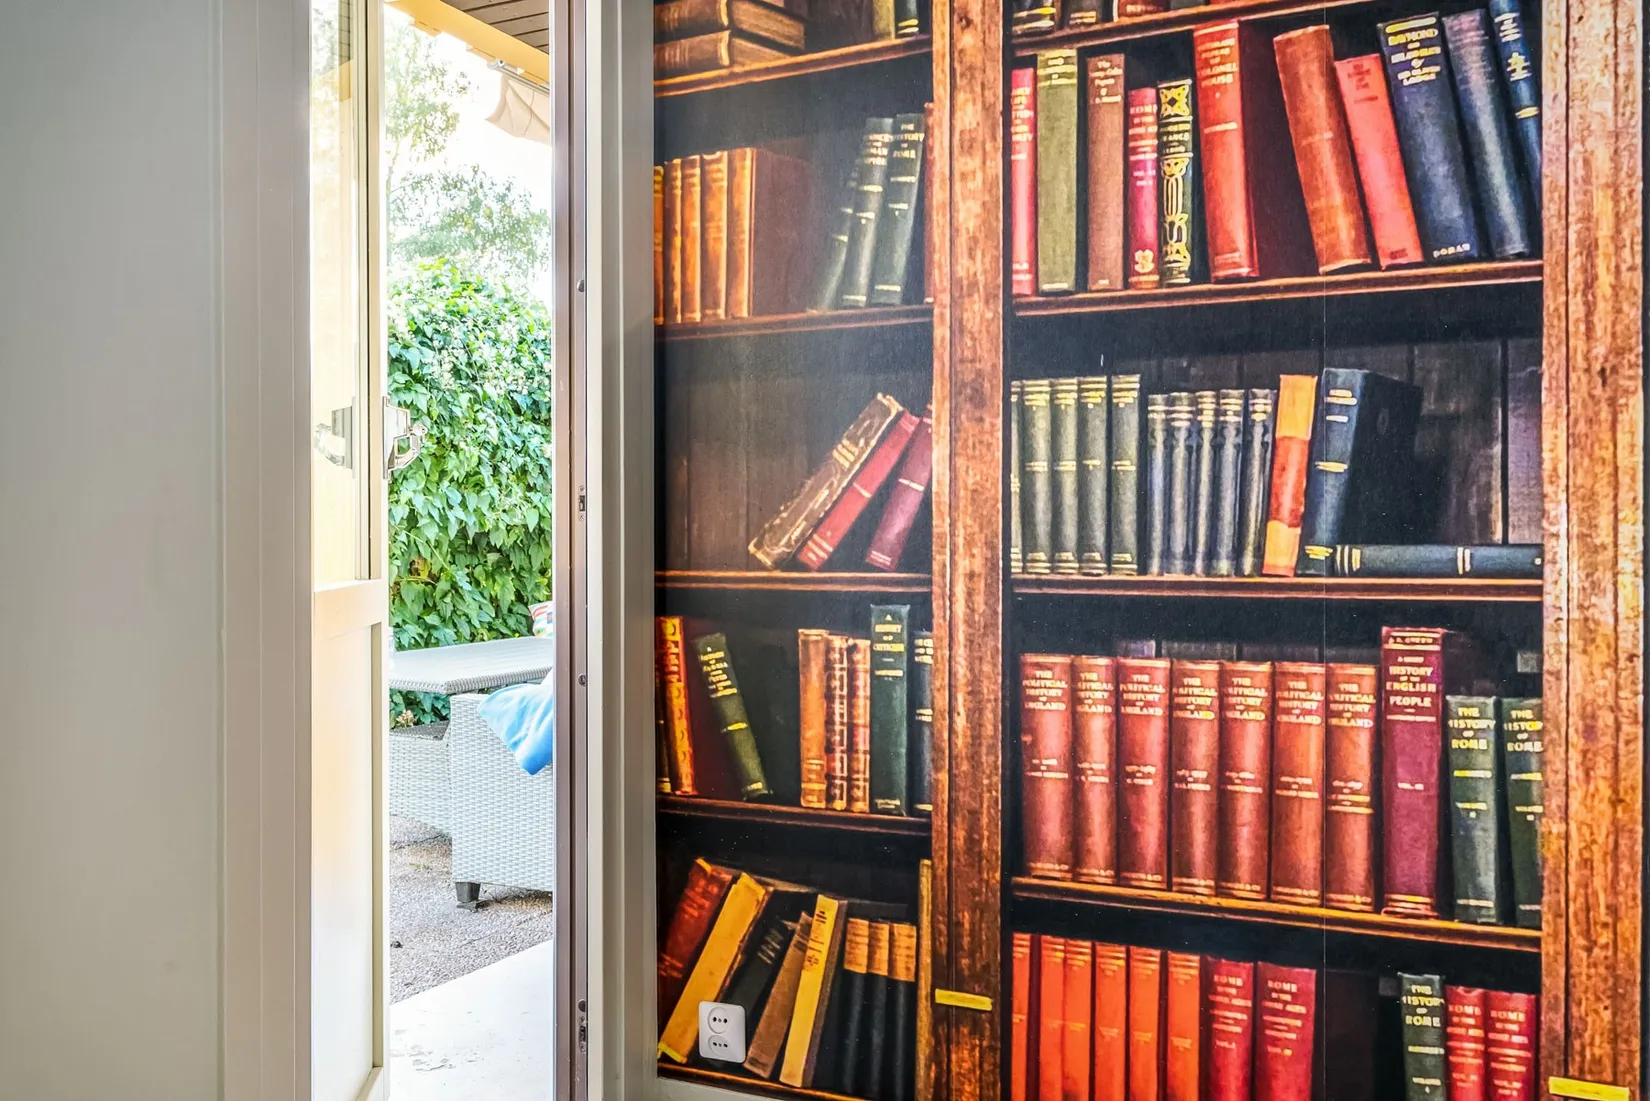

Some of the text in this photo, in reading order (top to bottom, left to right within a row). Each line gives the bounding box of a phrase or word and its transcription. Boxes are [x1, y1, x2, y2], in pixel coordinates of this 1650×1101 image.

[1389, 666, 1433, 677] HISTORY
[1386, 681, 1437, 693] ENGLISH
[1389, 696, 1432, 707] PEOPLE
